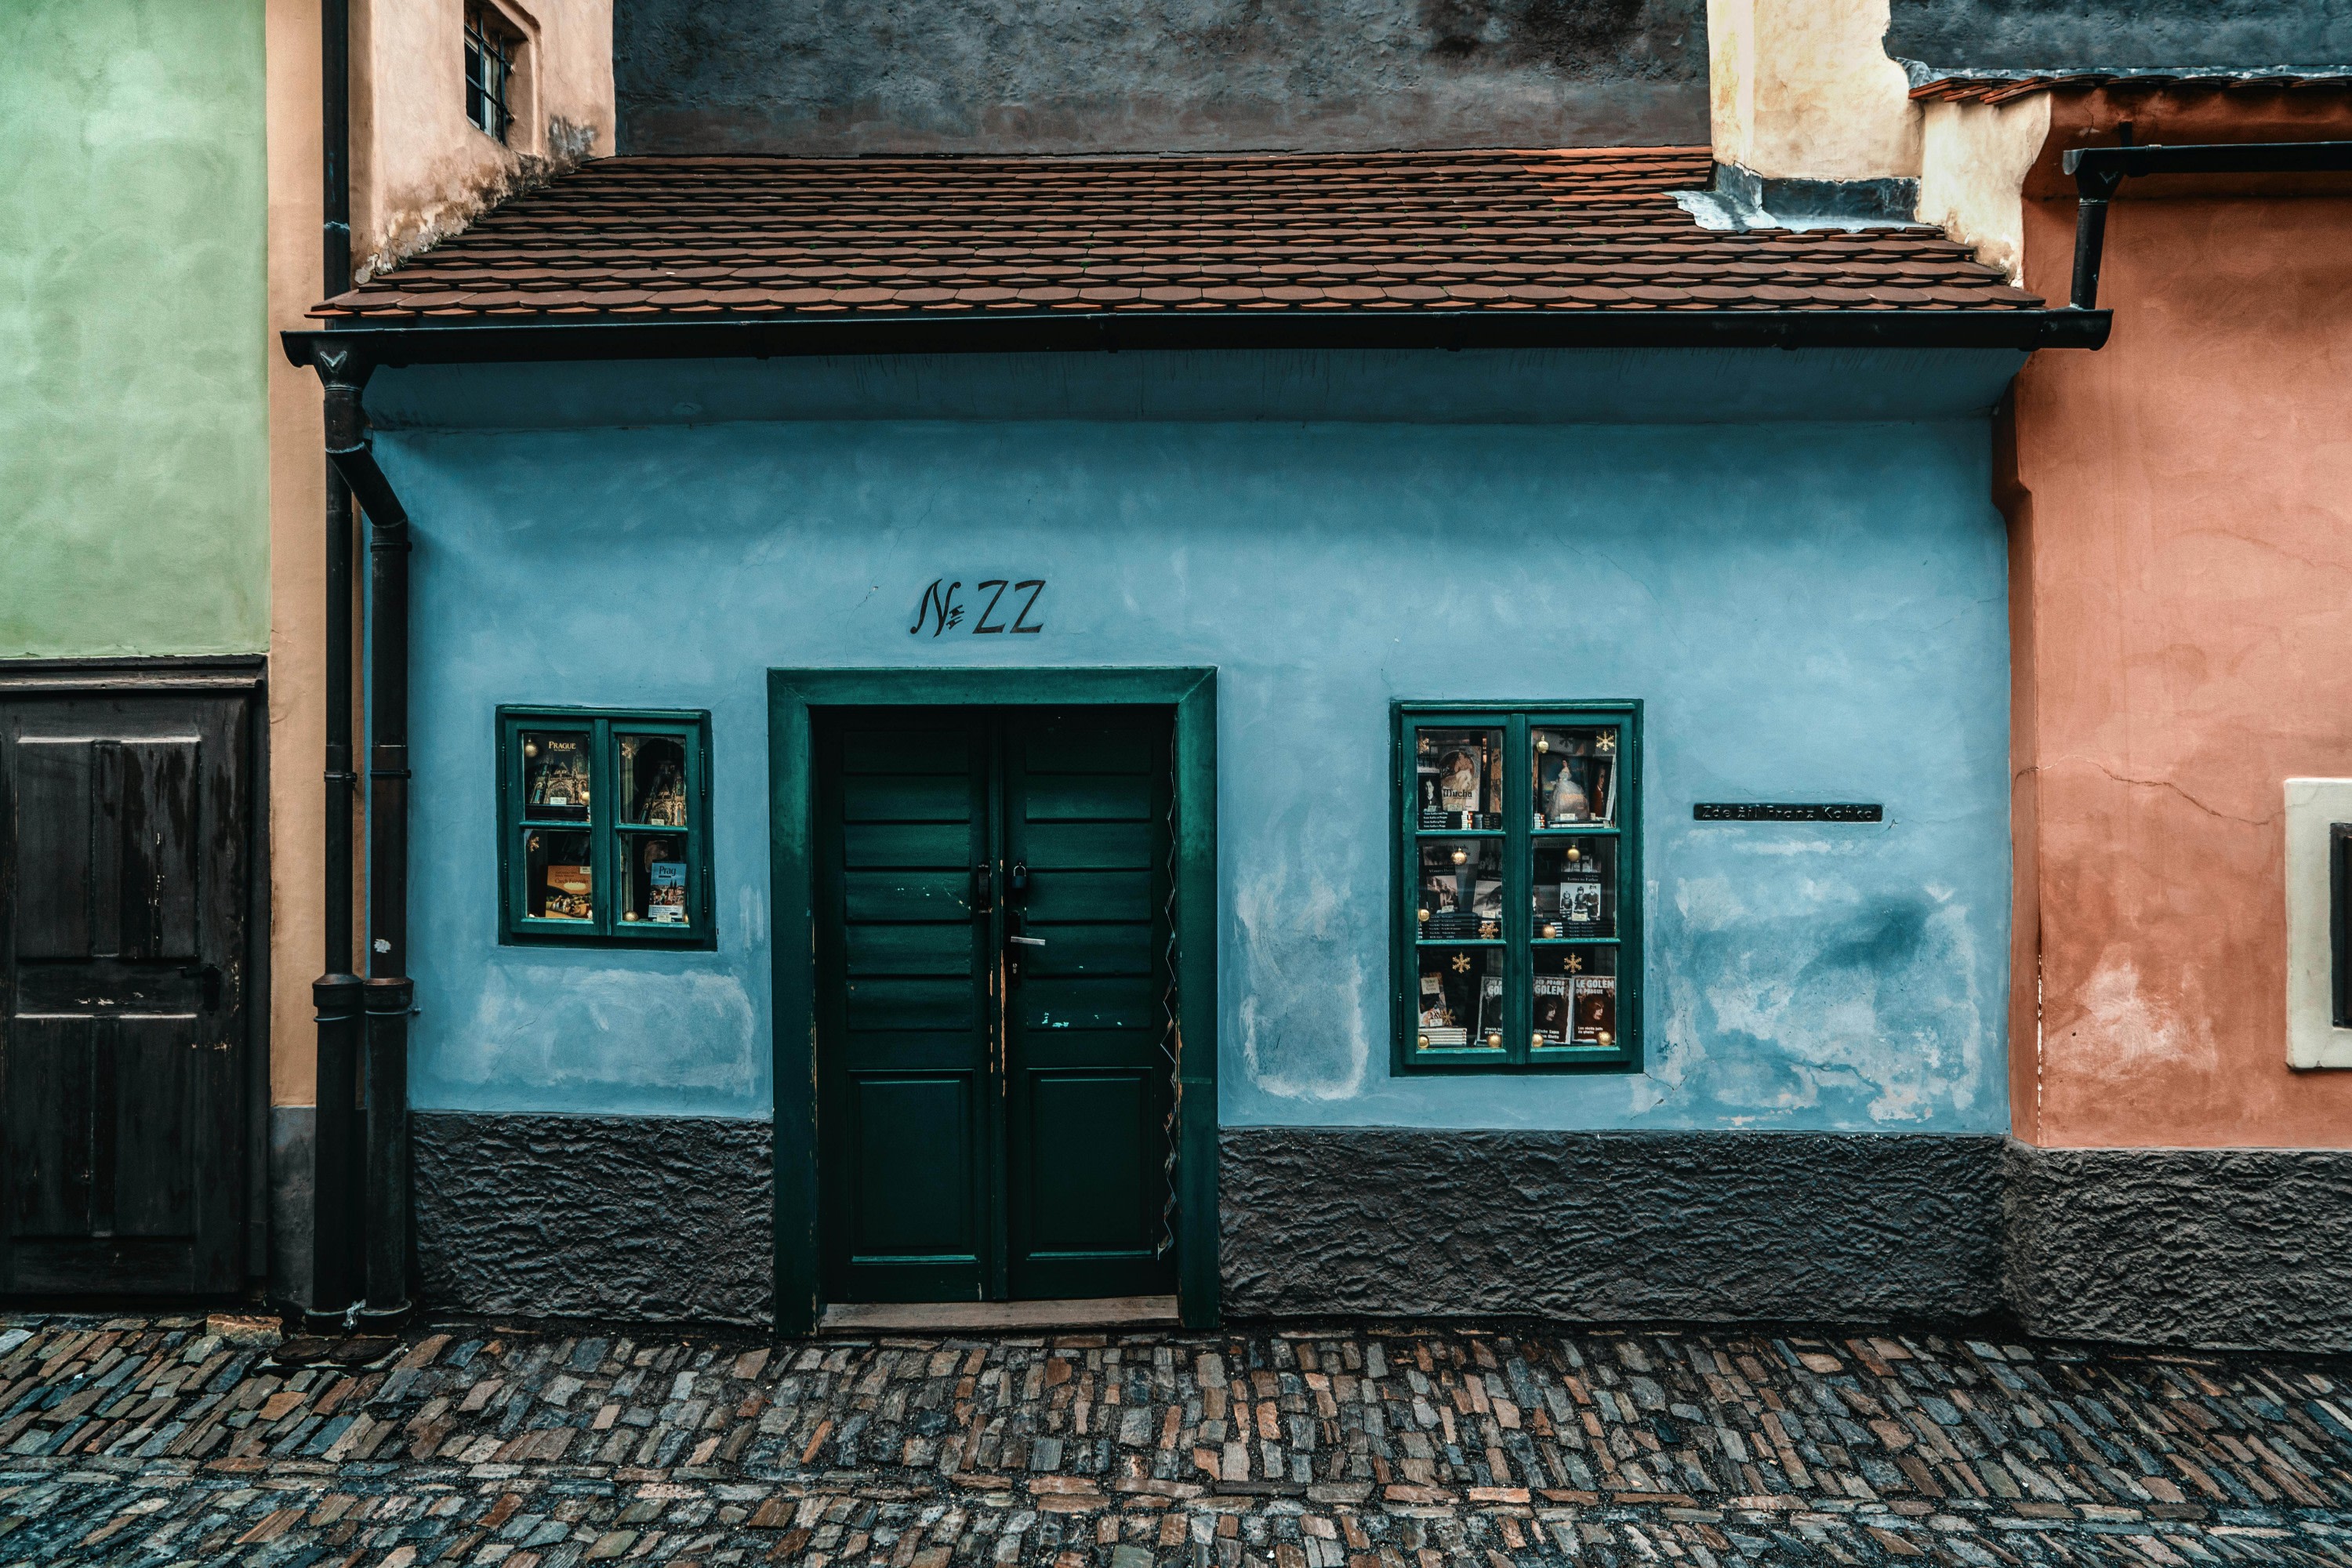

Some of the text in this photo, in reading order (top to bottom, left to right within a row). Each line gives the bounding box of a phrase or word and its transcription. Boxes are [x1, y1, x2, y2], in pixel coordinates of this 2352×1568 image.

[549, 741, 576, 750] PRAGUE
[1443, 789, 1472, 797] Mucha
[1702, 806, 1731, 818] Zde
[1766, 805, 1814, 819] Franz
[1823, 805, 1873, 819] Kafka
[659, 866, 676, 876] Prag
[1575, 979, 1614, 989] LE GOLEM
[1534, 985, 1565, 995] GOLEM
